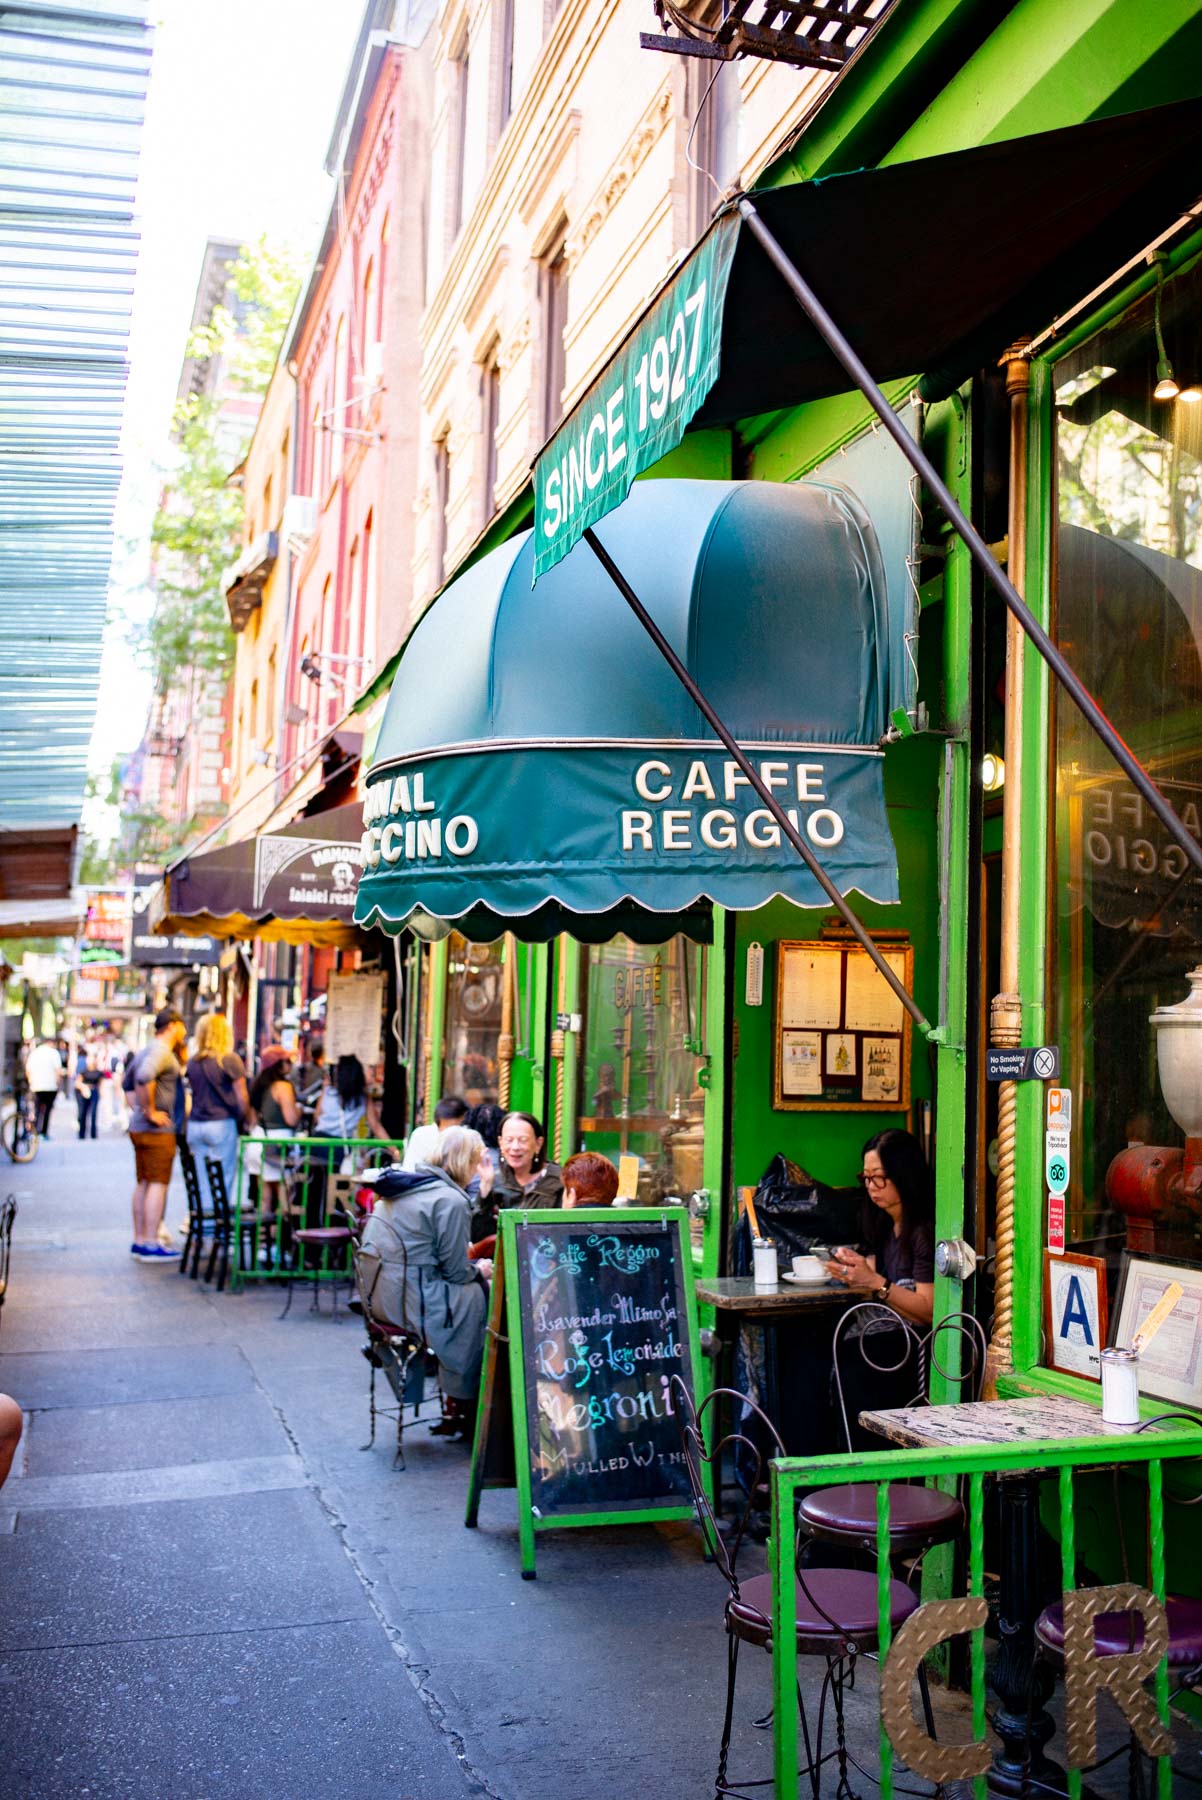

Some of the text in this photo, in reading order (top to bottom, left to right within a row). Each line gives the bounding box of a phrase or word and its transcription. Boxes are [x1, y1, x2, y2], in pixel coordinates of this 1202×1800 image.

[543, 278, 707, 538] SINCE 1927
[635, 760, 826, 802] CAFFE
[622, 809, 845, 850] REGGIO
[990, 1054, 1025, 1064] No Smoking
[990, 1065, 1019, 1074] Or Vaping
[326, 1174, 355, 1215] R
[586, 1234, 660, 1274] Reggio
[537, 1303, 616, 1333] Lavender
[1060, 1275, 1094, 1347] A
[601, 1330, 684, 1376] Lemonade
[540, 1447, 629, 1481] MULLED
[881, 1583, 1176, 1783] C R
